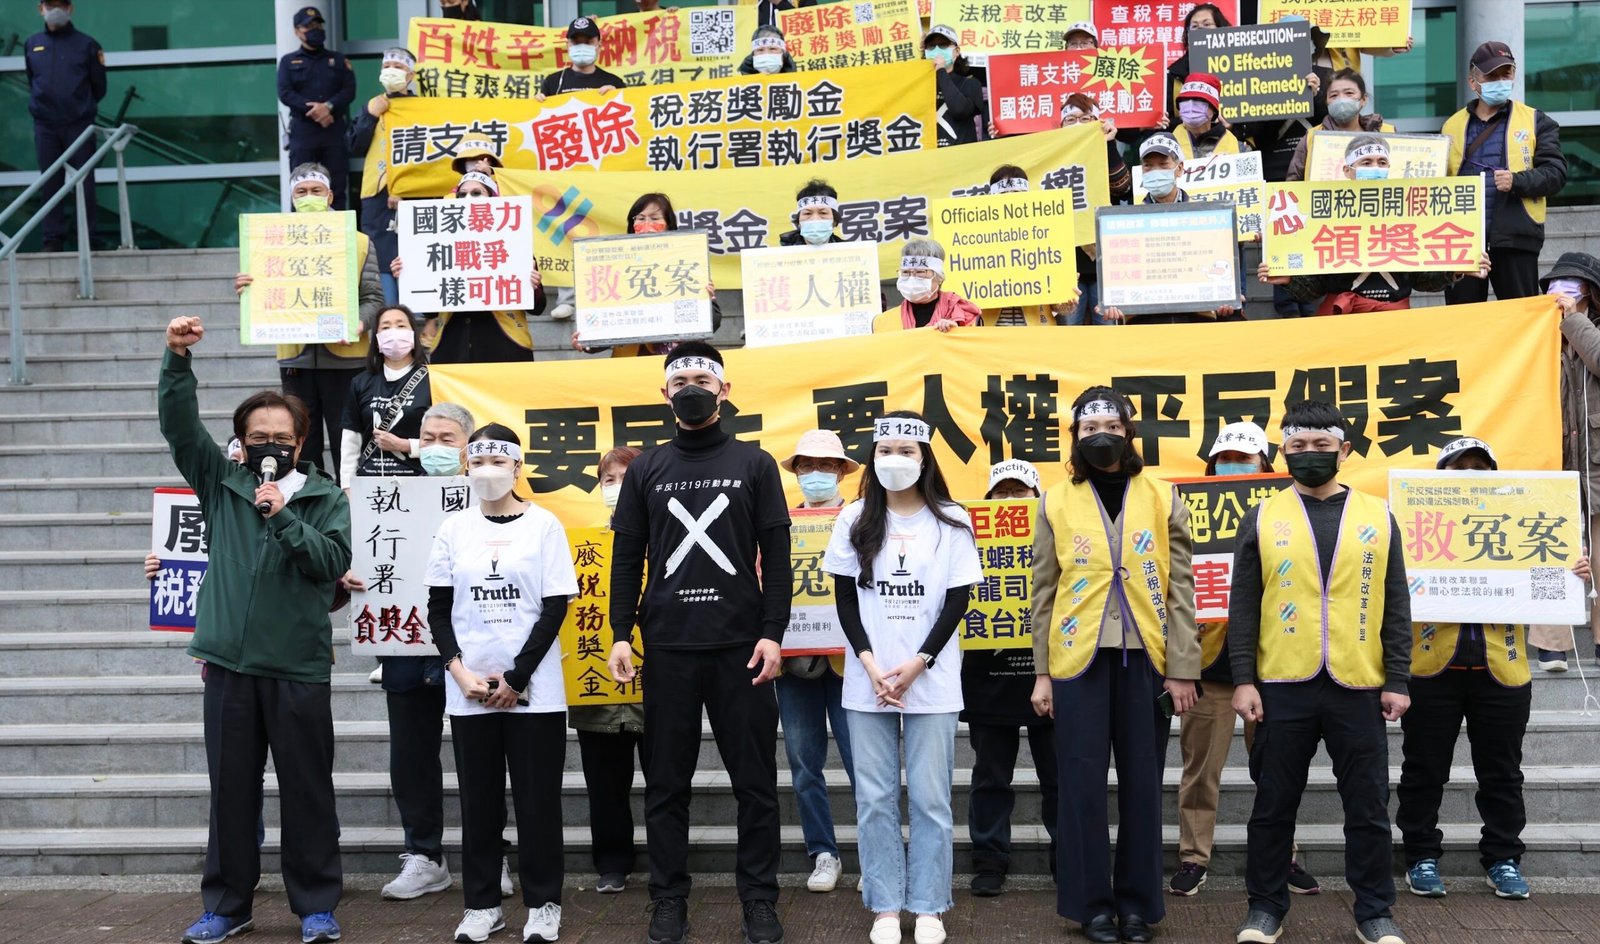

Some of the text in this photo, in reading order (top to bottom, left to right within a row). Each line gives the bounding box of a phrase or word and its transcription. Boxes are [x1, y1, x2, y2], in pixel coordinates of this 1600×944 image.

[780, 6, 852, 37] 廢除
[960, 4, 1067, 24] 法稅真改革
[783, 20, 911, 58] 稅務獎勵金
[960, 28, 1065, 50] 良心救台灣
[1019, 56, 1140, 87] 請支持 廢除
[1208, 52, 1293, 73] NO Effective
[1250, 74, 1306, 95] Remedy
[650, 81, 843, 129] 稅務獎勵金
[999, 87, 1154, 121] 國稅局 獎勵金
[1241, 99, 1310, 117] Persecution
[532, 101, 640, 170] 廢除
[648, 115, 922, 170] 執行署執行獎金
[1186, 162, 1231, 183] 1219
[941, 200, 1065, 225] Officials Not Held
[1268, 189, 1304, 235] 小心
[1310, 185, 1477, 219] 國稅局開假稅單
[413, 202, 522, 235] 國家暴力
[952, 227, 1049, 247] Accountable for
[1311, 221, 1476, 269] 領獎金
[264, 255, 332, 278] 救冤案
[427, 240, 509, 273] 和戰爭
[950, 247, 1062, 273] Human Rights
[411, 275, 523, 307] 一樣可怕
[584, 260, 701, 303] 救冤案
[754, 271, 872, 314] 護人權
[963, 279, 1041, 300] Violations
[264, 287, 333, 310] 護人權
[812, 373, 1061, 465] 要人權
[1107, 358, 1464, 467] 平反假案
[895, 422, 925, 437] 1219
[992, 463, 1029, 477] Rectify
[654, 479, 742, 493] 平反1219行動聯盟
[366, 486, 410, 595] 執行署
[1405, 511, 1569, 563] 救冤案
[470, 583, 521, 601] Truth
[876, 580, 925, 597] Truth
[969, 575, 1034, 603] 龍司
[1191, 561, 1232, 611] 害
[1429, 576, 1488, 585] 法稅改革聯盟
[574, 540, 613, 698] 廢稅務獎金
